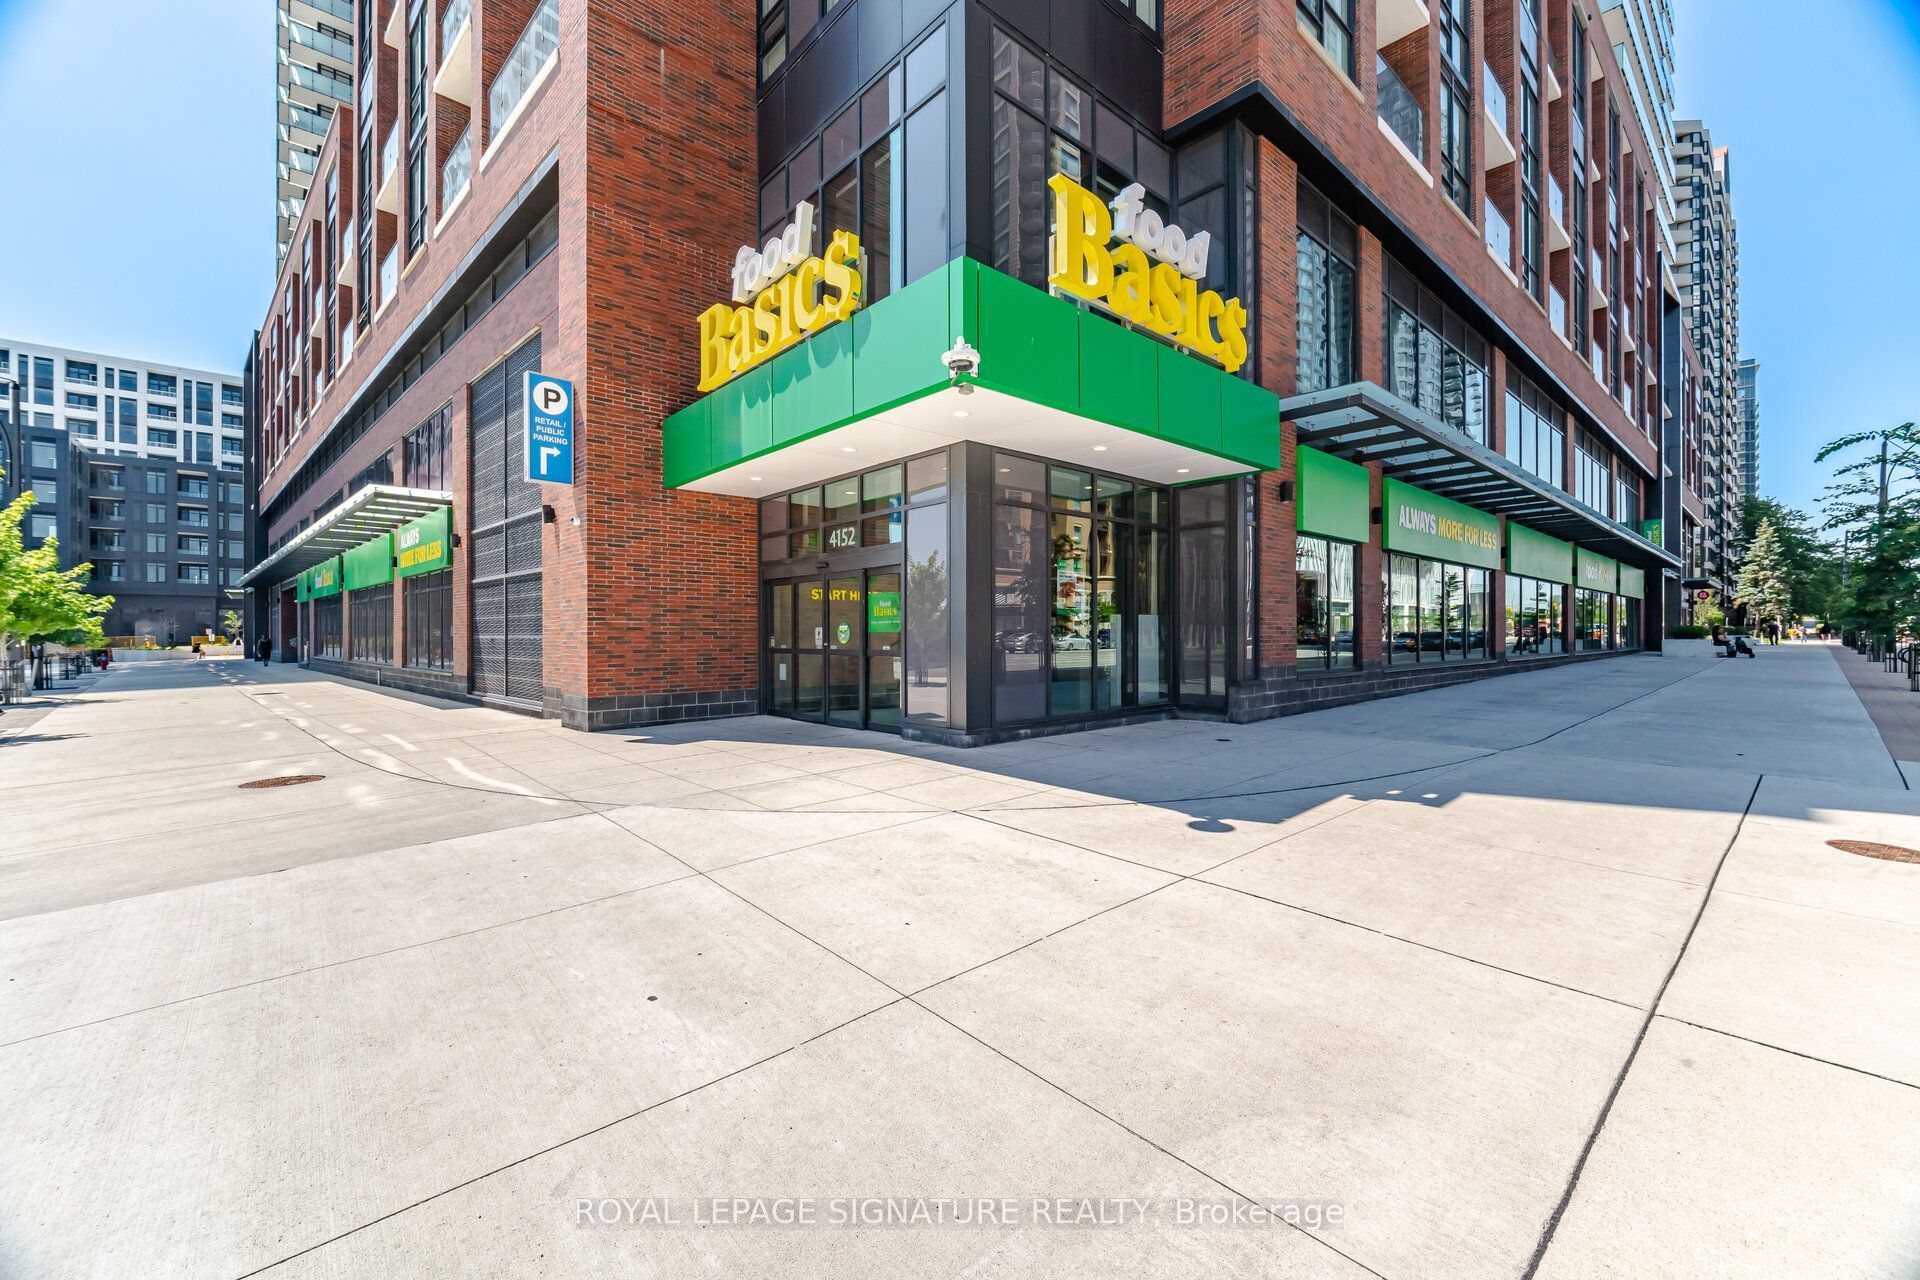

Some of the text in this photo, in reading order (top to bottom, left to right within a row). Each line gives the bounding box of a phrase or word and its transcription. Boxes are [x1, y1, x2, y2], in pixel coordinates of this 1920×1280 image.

[1109, 182, 1211, 280] food
[732, 200, 813, 303] food
[543, 387, 561, 410] P
[535, 416, 562, 428] RETAIL
[536, 426, 565, 436] PUBLIC
[533, 433, 568, 446] PARKING
[829, 526, 856, 548] 4152
[1399, 505, 1497, 551] ALWAYS MORE FOR LESS
